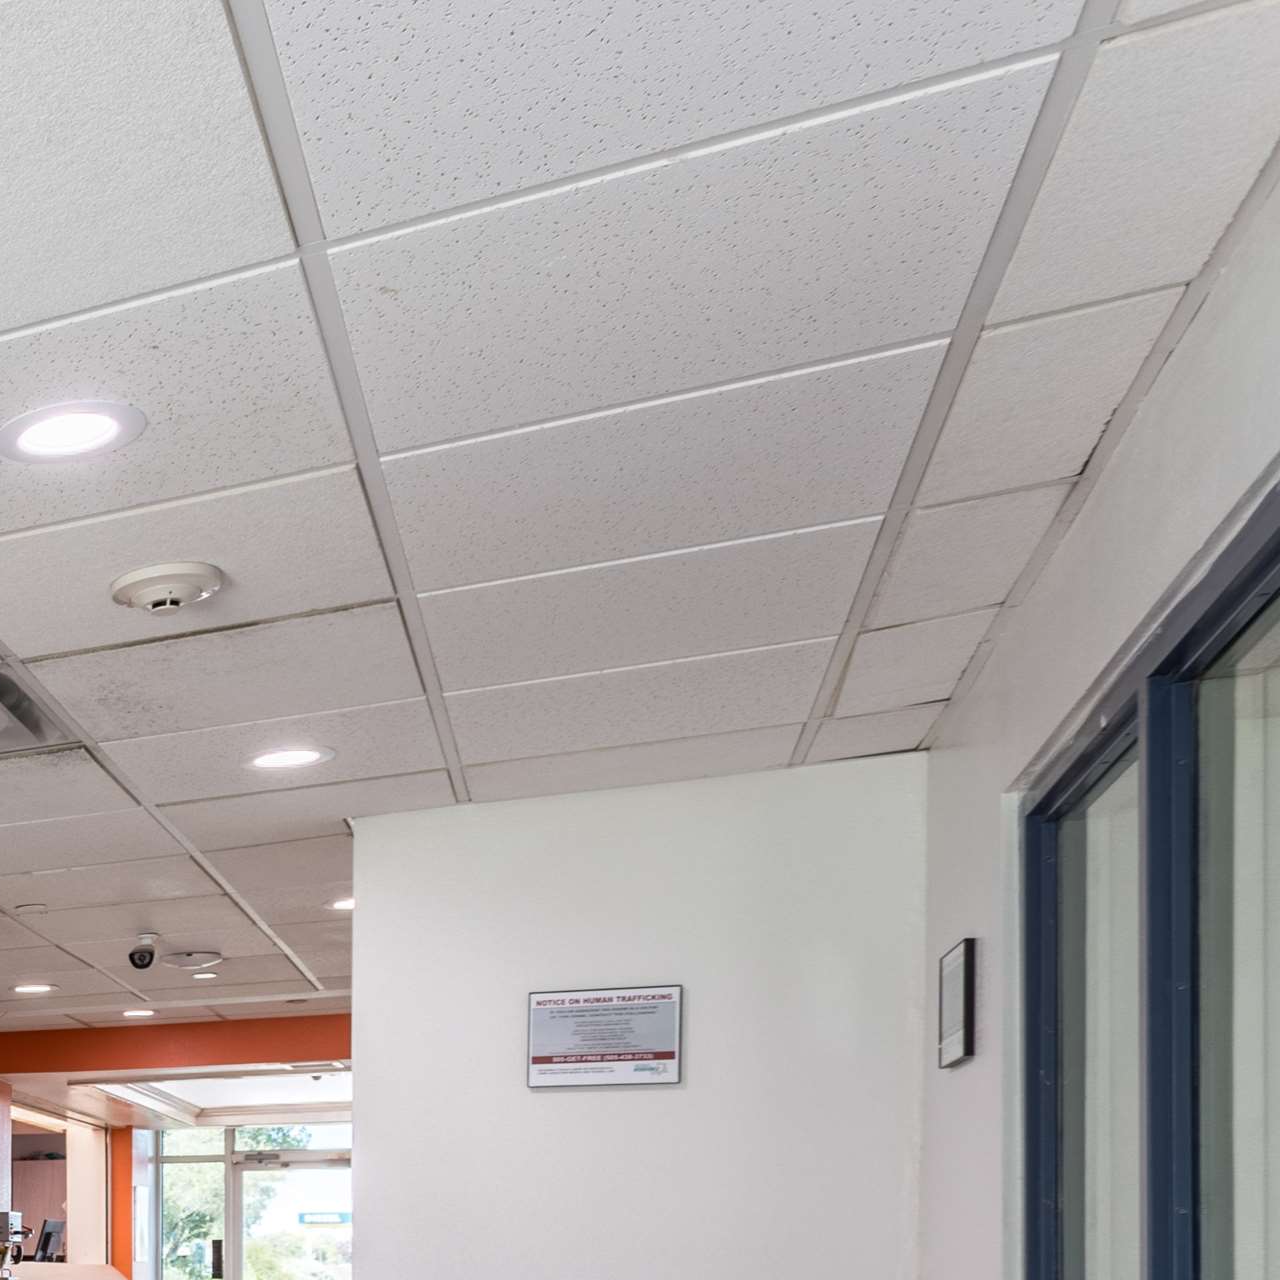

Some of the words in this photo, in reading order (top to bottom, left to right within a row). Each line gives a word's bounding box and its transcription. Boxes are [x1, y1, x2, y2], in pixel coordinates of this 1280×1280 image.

[535, 998, 566, 1007] NOTICE
[568, 997, 581, 1006] ON
[583, 995, 614, 1004] HUMAN
[617, 992, 673, 1003] TRAFFICKING
